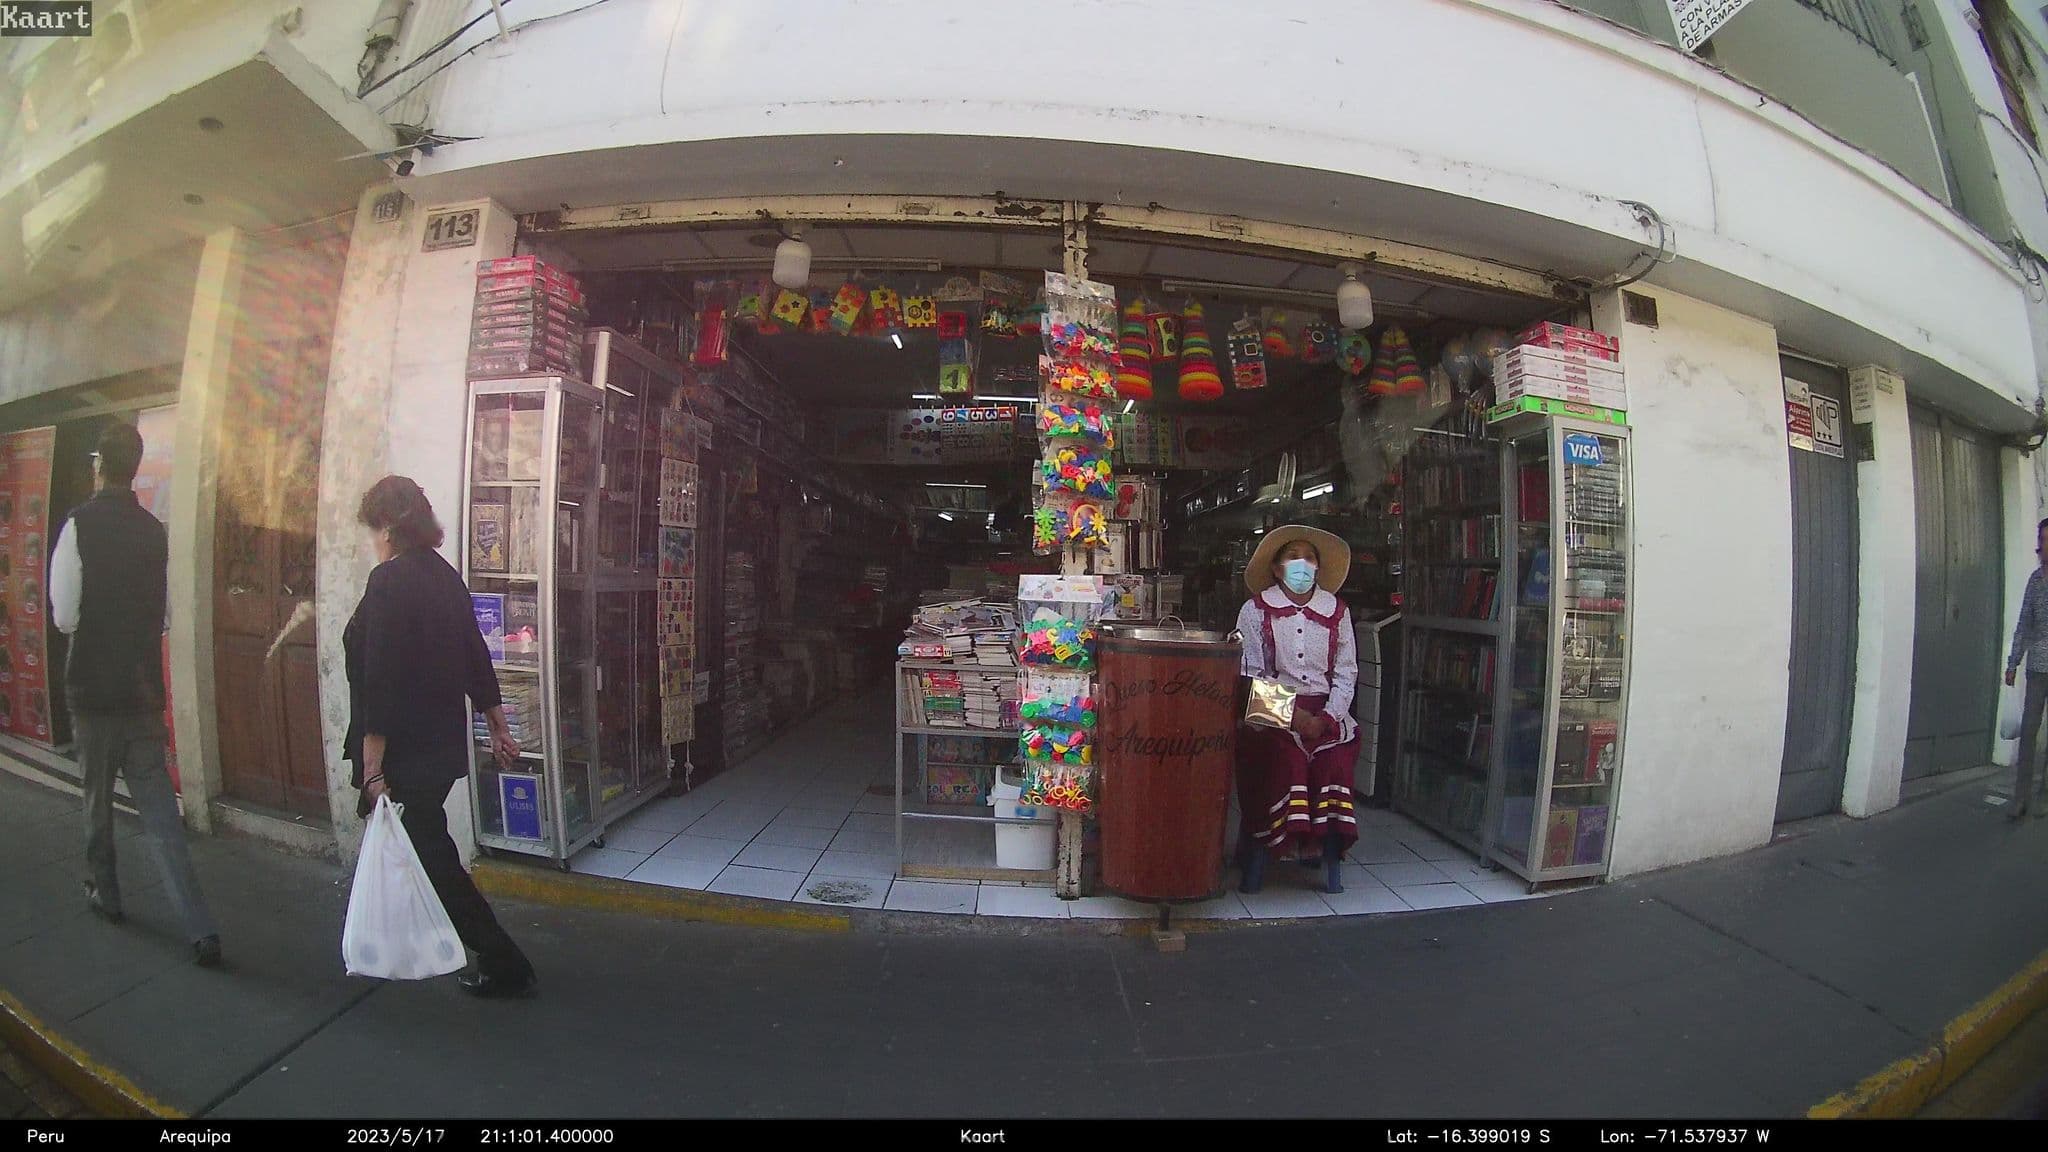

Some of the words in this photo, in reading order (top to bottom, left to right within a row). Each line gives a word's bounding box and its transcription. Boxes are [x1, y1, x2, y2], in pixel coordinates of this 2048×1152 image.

[1680, 4, 1703, 29] CON
[1681, 31, 1689, 42] A
[1690, 17, 1705, 33] LA
[1705, 0, 1729, 19] PLA
[1686, 32, 1703, 49] DE
[1704, 0, 1743, 36] ARMAS
[429, 212, 475, 242] 113
[1567, 442, 1600, 461] VISA
